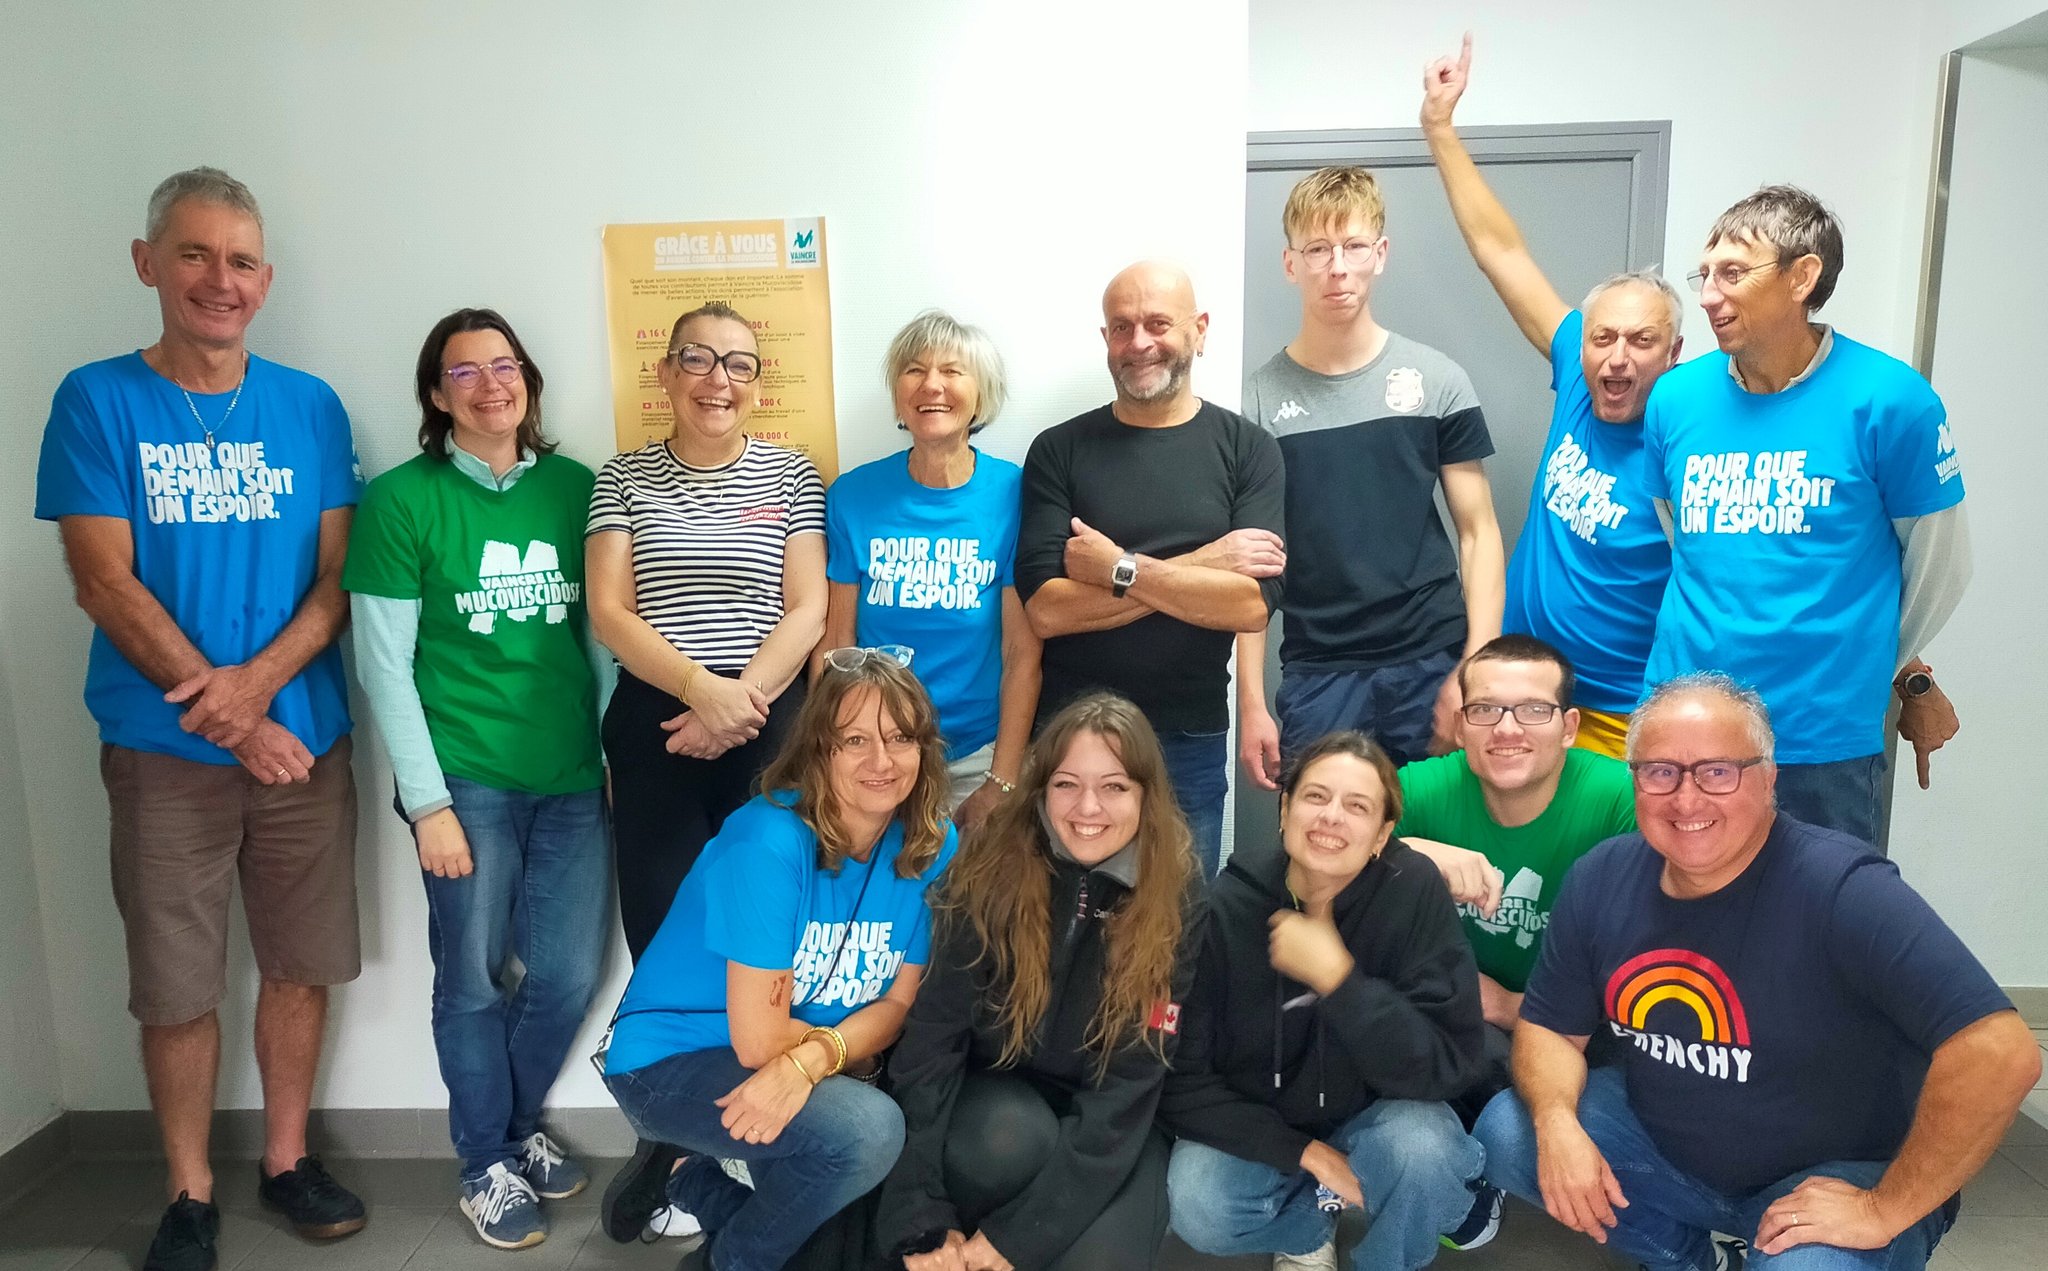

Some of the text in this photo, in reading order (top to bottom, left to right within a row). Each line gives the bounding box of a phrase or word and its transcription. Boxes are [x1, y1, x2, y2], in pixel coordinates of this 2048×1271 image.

[655, 232, 709, 256] GRÂCE
[731, 232, 777, 254] VOUS
[791, 251, 816, 260] VAINCRE
[650, 329, 659, 337] 16
[755, 431, 764, 439] 50
[766, 431, 782, 440] 000
[139, 442, 266, 471] POUR QUE
[1684, 450, 1808, 482] POUR QUE
[143, 467, 294, 497] DEMAIN SOIT
[1579, 467, 1618, 498] QUE
[1681, 477, 1836, 508] DEMAIN SOIT
[146, 493, 280, 524] UN ESPOIR.
[1580, 493, 1629, 530] SOIT
[1680, 504, 1811, 535] UN ESPOIR.
[869, 537, 981, 564] POUR QUE
[478, 570, 565, 591] VAINCRE LA
[868, 560, 951, 587] DEMAIN
[866, 580, 983, 610] UN ESPOIR.
